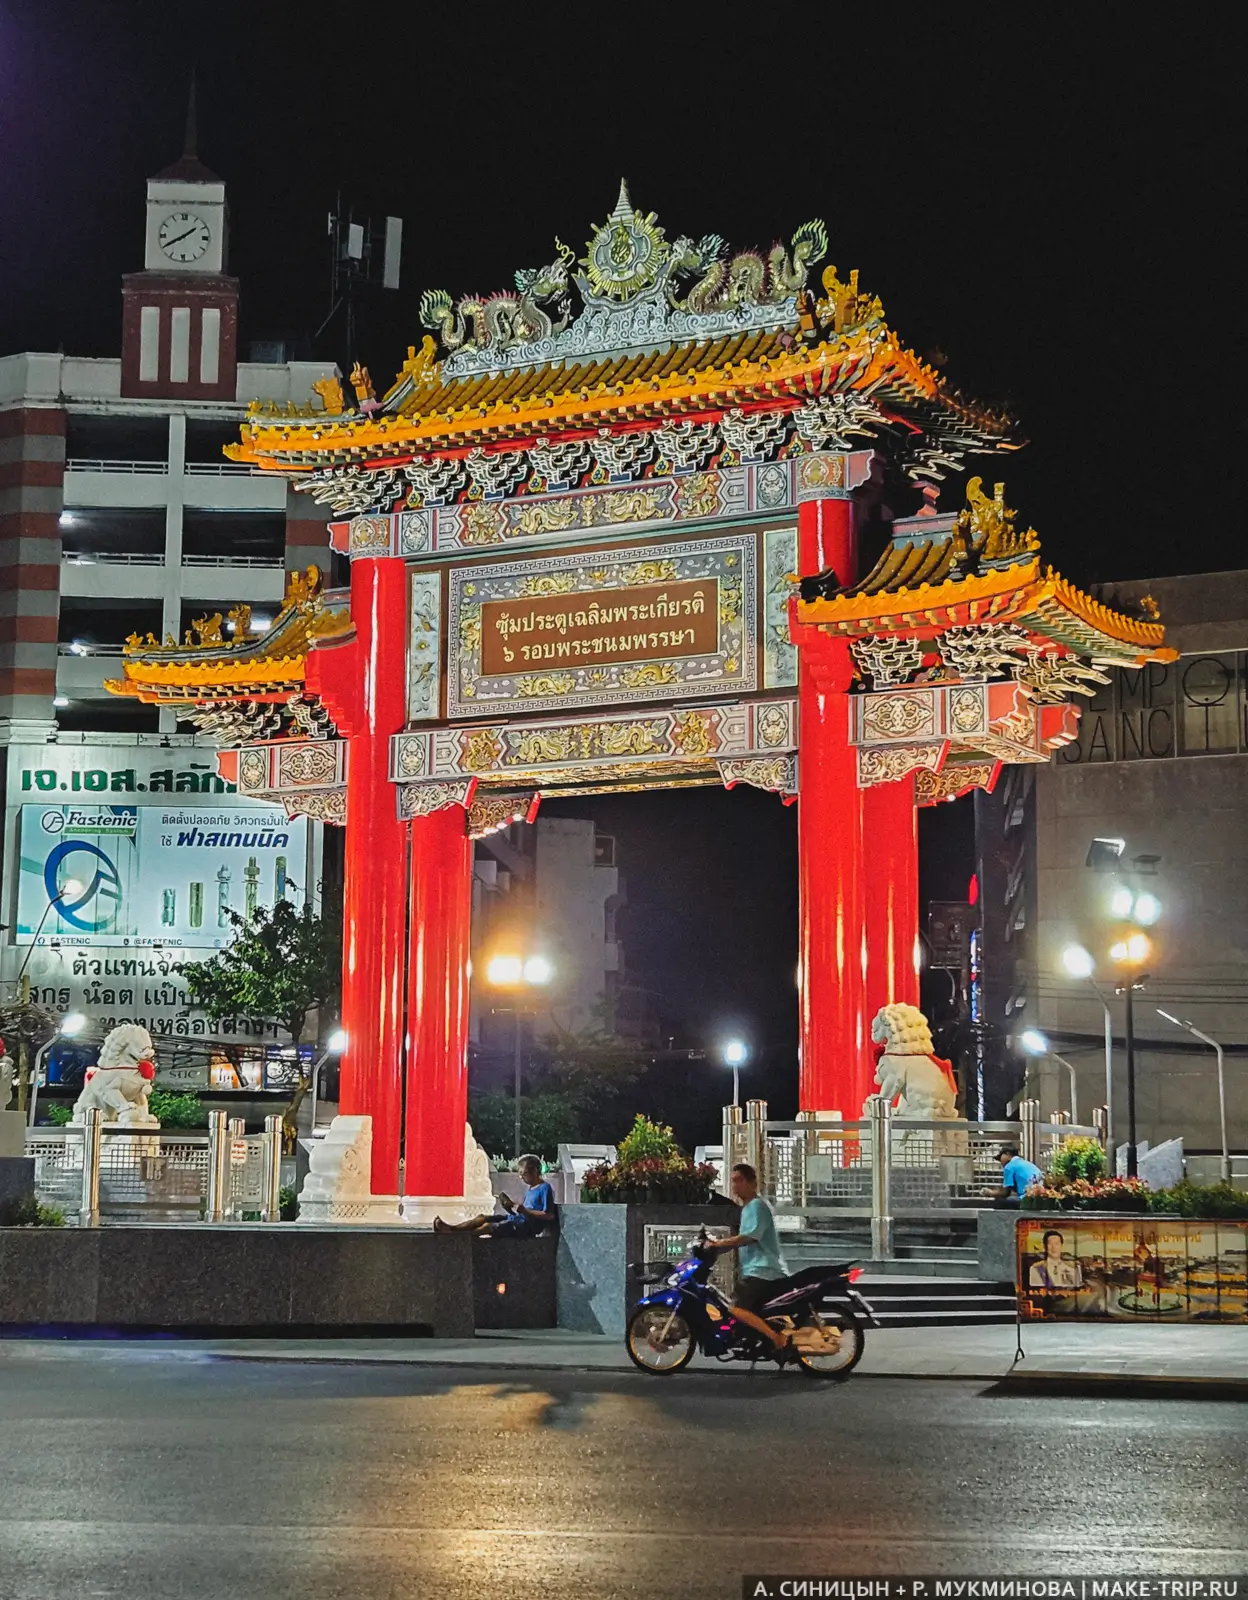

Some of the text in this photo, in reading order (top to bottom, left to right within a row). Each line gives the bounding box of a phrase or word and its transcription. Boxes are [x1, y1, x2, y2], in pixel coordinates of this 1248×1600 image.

[495, 590, 705, 641] ซุ้มประตูเฉลิมพระเกียรติ
[503, 627, 695, 663] ๖ รอบพระชนมพรรษา
[21, 763, 237, 793] เจ.เอส.สลัก
[67, 811, 138, 826] Fastenic
[161, 811, 231, 826] ติดตั้งปลอดภัย
[161, 827, 289, 848] ใช้ ฟาสเทนนิค
[83, 980, 133, 1006] น๊อต
